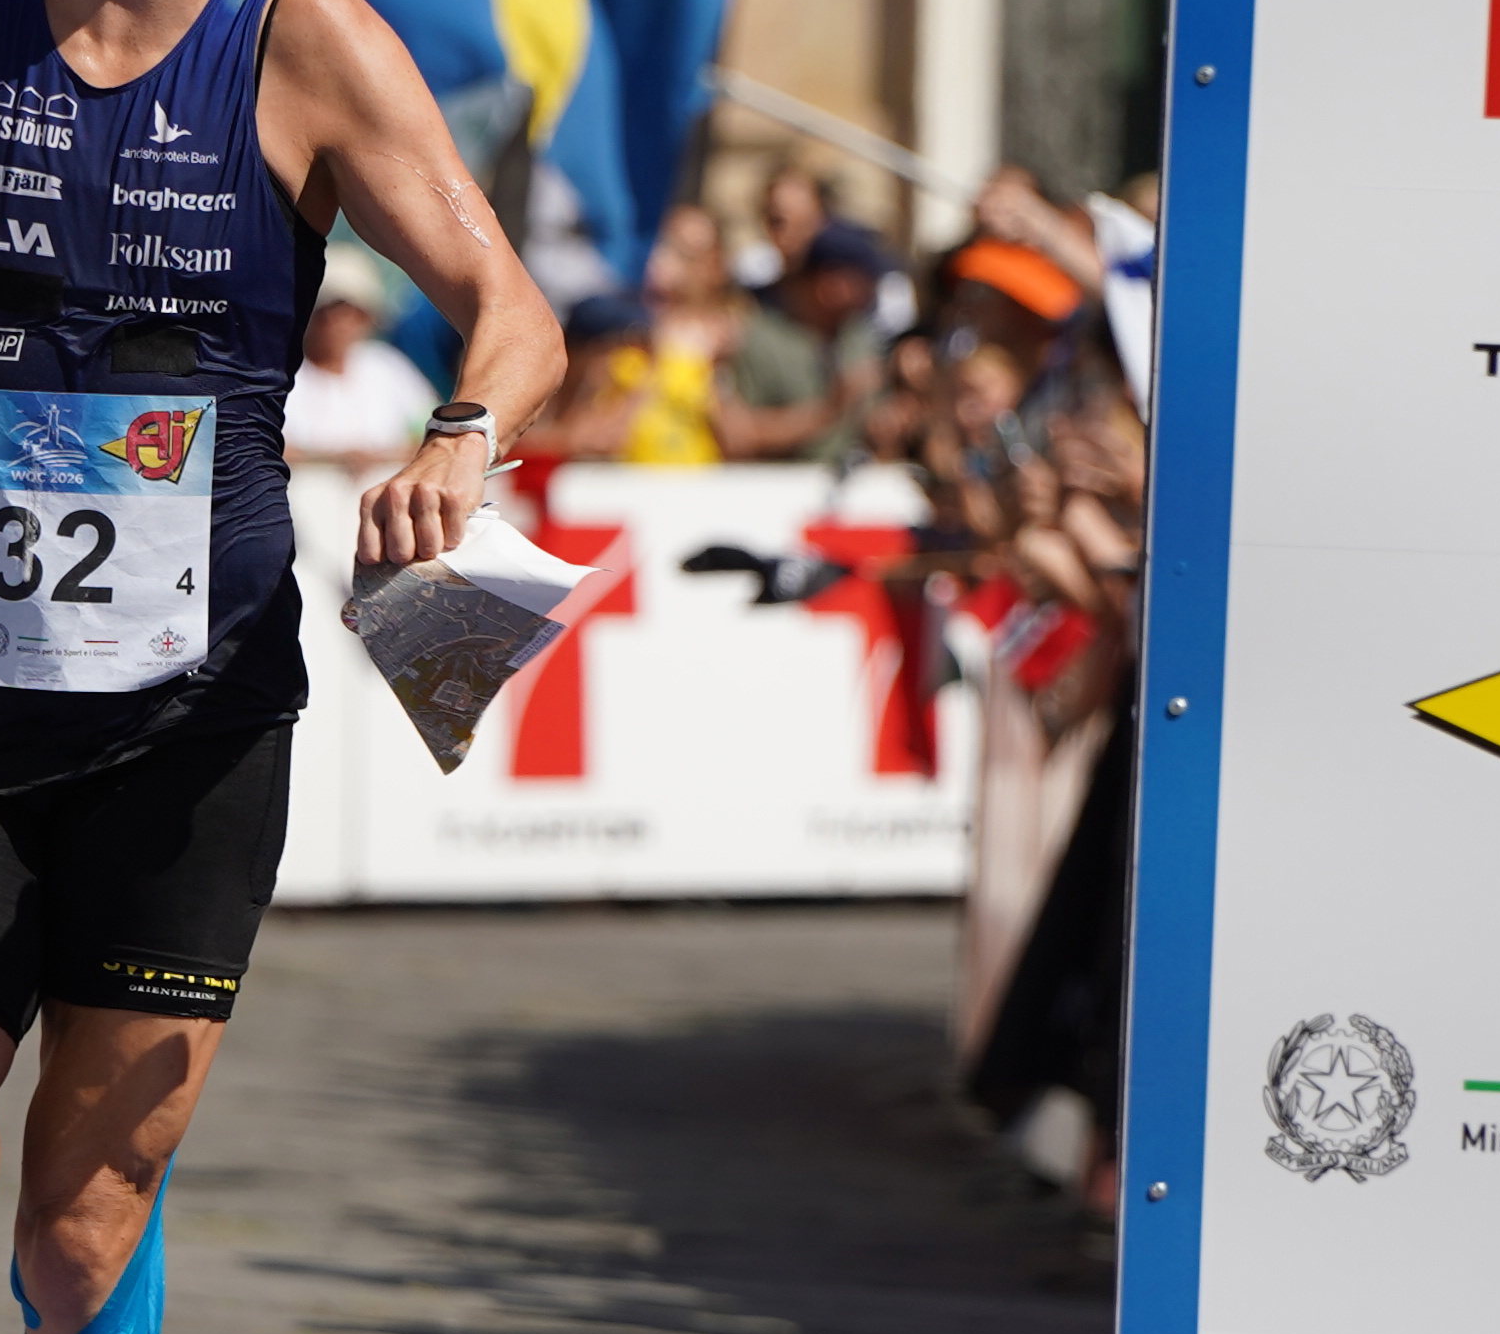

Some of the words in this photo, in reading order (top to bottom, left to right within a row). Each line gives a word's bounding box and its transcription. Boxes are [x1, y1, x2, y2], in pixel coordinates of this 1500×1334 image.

[191, 151, 220, 165] Bank
[2, 170, 46, 193] Fjäll
[112, 183, 237, 213] bagheera
[107, 232, 232, 273] Folksam
[104, 294, 157, 313] JAMA
[160, 297, 229, 315] LIVING
[10, 469, 46, 484] WOC
[49, 470, 85, 485] 2026
[175, 566, 196, 597] 4
